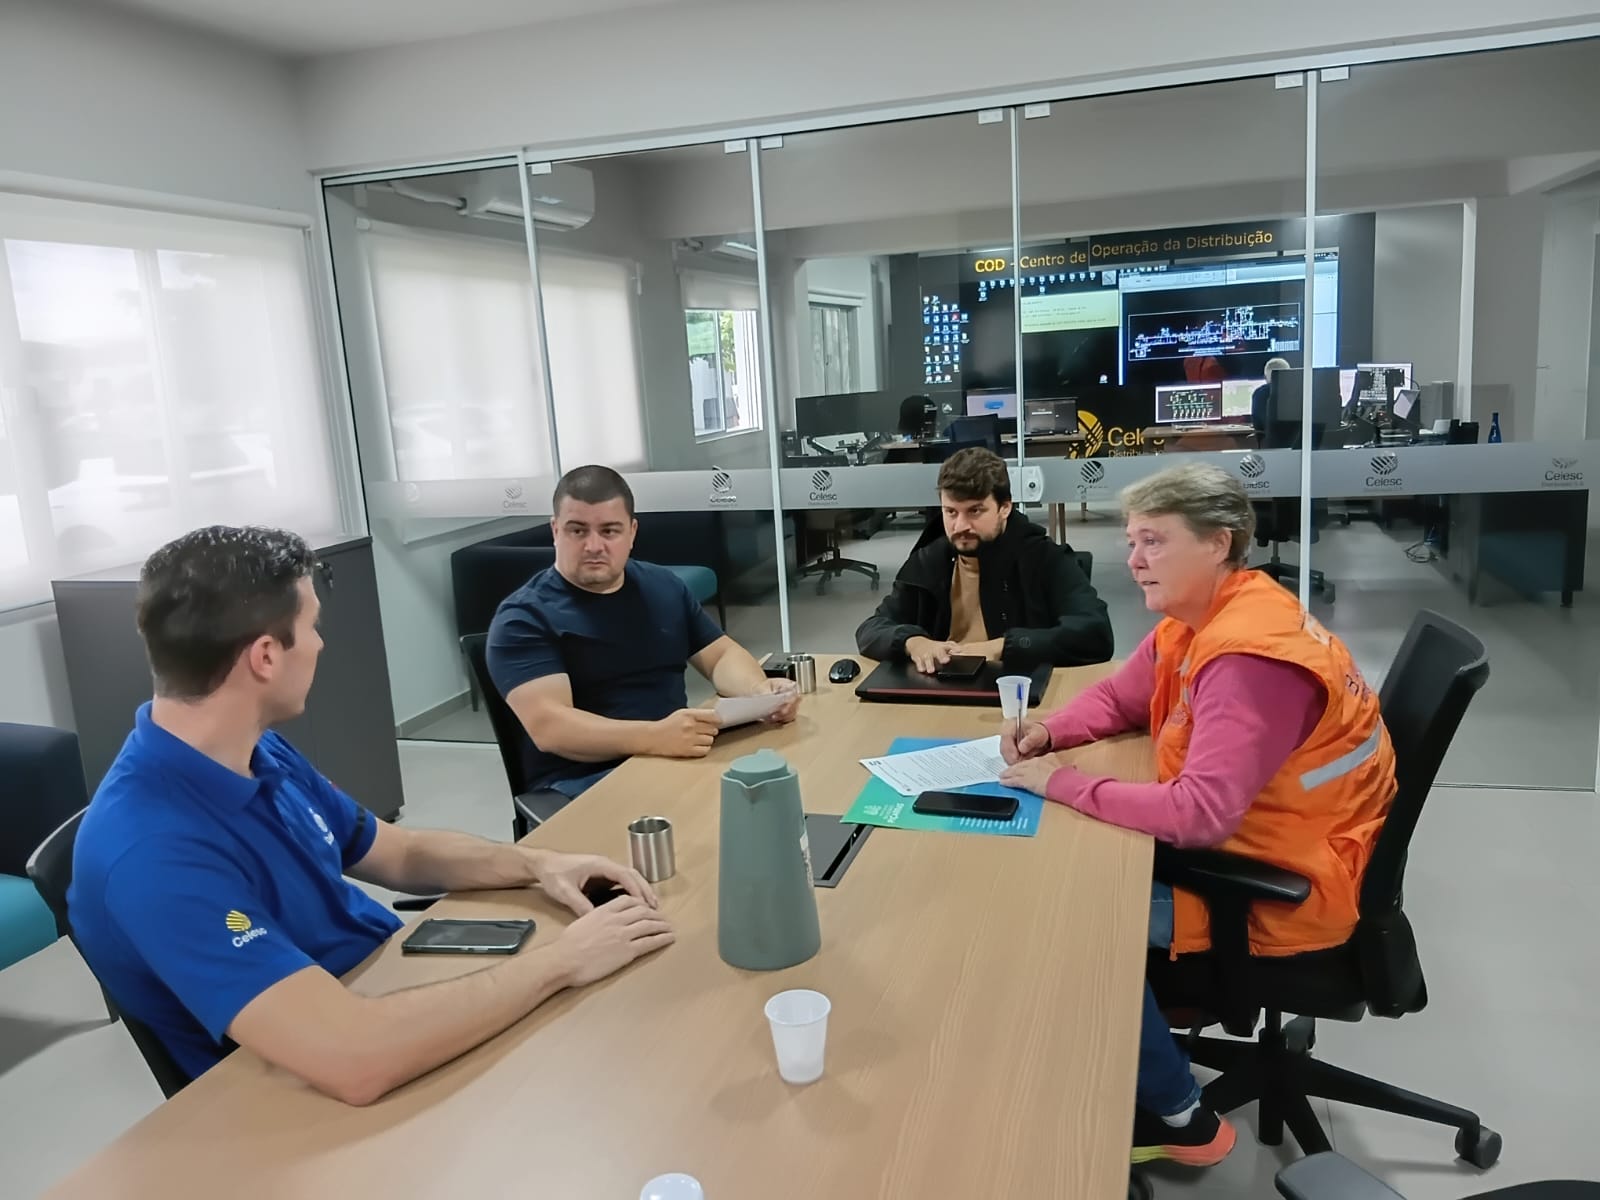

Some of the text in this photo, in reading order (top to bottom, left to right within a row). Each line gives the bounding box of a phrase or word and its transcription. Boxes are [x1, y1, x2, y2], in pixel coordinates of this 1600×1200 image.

[975, 258, 1006, 273] COD
[1019, 254, 1065, 268] Centro
[1069, 251, 1087, 263] de
[1091, 239, 1159, 259] Operação
[1163, 237, 1181, 251] da
[1186, 229, 1273, 249] Distribuição
[1365, 476, 1403, 488] Celesc
[809, 491, 838, 502] Celesc
